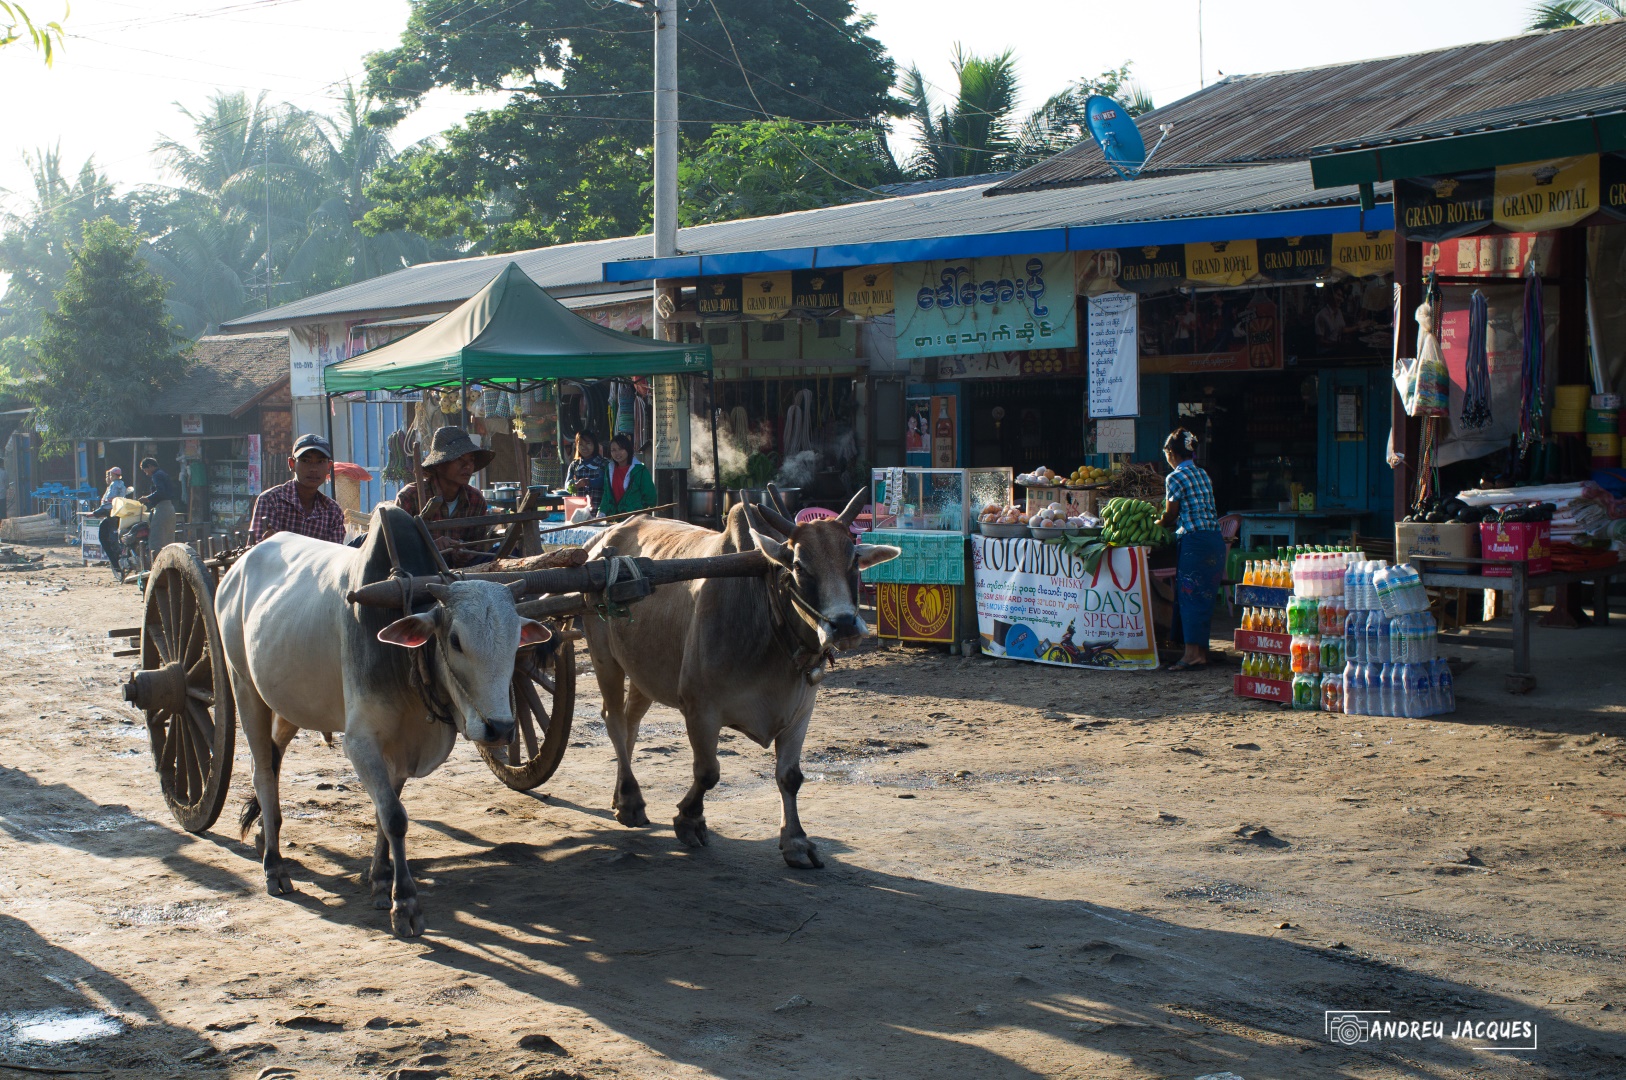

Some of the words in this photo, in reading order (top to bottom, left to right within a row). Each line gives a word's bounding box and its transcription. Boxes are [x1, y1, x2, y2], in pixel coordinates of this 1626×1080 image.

[1502, 193, 1543, 218] GRAND
[1549, 187, 1590, 212] ROYAL
[1405, 205, 1443, 228] GRAND
[1447, 200, 1485, 222] ROYAL
[1264, 253, 1293, 270] GRAND
[1295, 250, 1325, 267] ROYAL
[1339, 246, 1373, 264] GRAND
[1123, 265, 1150, 281] GRAND
[1153, 262, 1181, 278] ROYAL
[1192, 259, 1221, 276] GRAND
[1223, 255, 1252, 272] ROYAL
[700, 299, 719, 312] GRAND
[720, 297, 739, 312] ROYAL
[746, 296, 767, 310] GRAND
[768, 295, 788, 310] ROYAL
[796, 294, 818, 308] GRAND
[820, 292, 840, 307] ROYAL
[848, 290, 870, 306] GRAND
[872, 289, 893, 304] ROYAL
[1050, 576, 1085, 590] WHISKY
[1084, 588, 1141, 615] DAYS
[1083, 612, 1144, 630] SPECIAL
[1257, 636, 1283, 649] Max
[1255, 682, 1281, 696] Max
